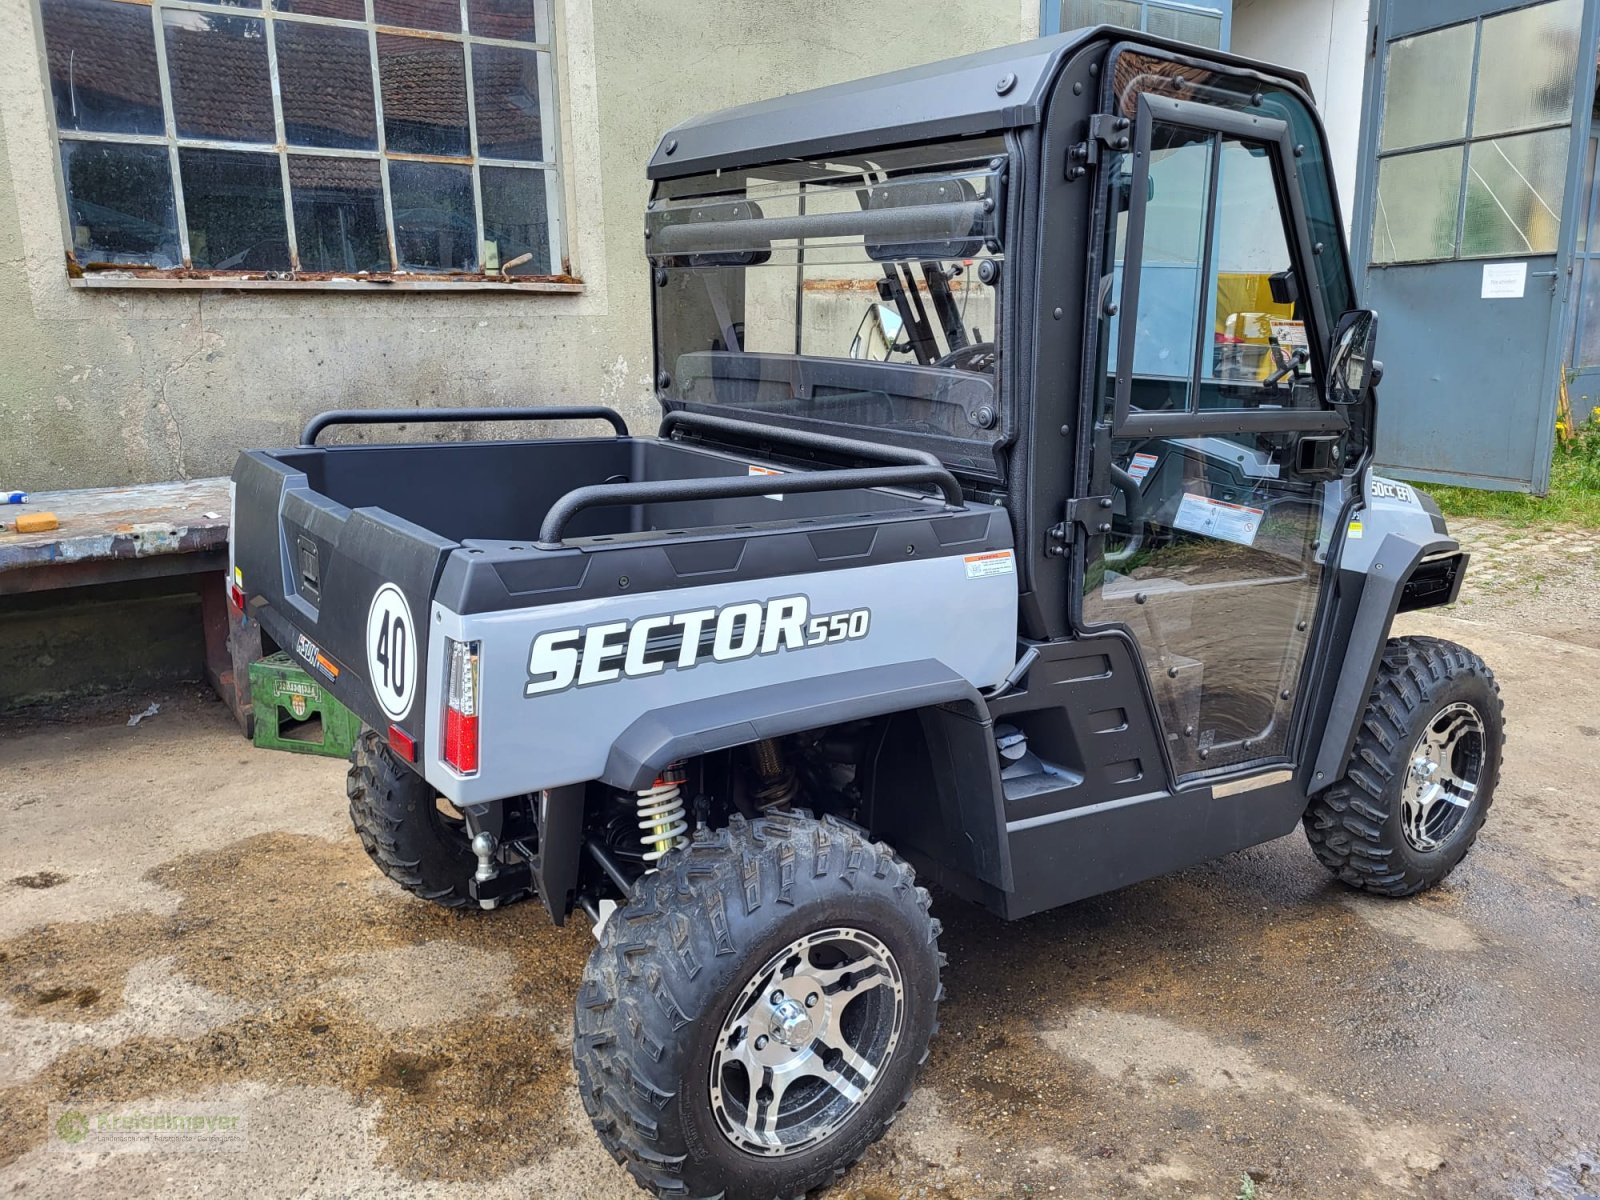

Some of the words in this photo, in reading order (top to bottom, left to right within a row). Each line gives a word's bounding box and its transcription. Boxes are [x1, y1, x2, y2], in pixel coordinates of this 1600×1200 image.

[376, 608, 406, 698] 40
[525, 596, 808, 695] SECTOR
[807, 609, 869, 646] 550
